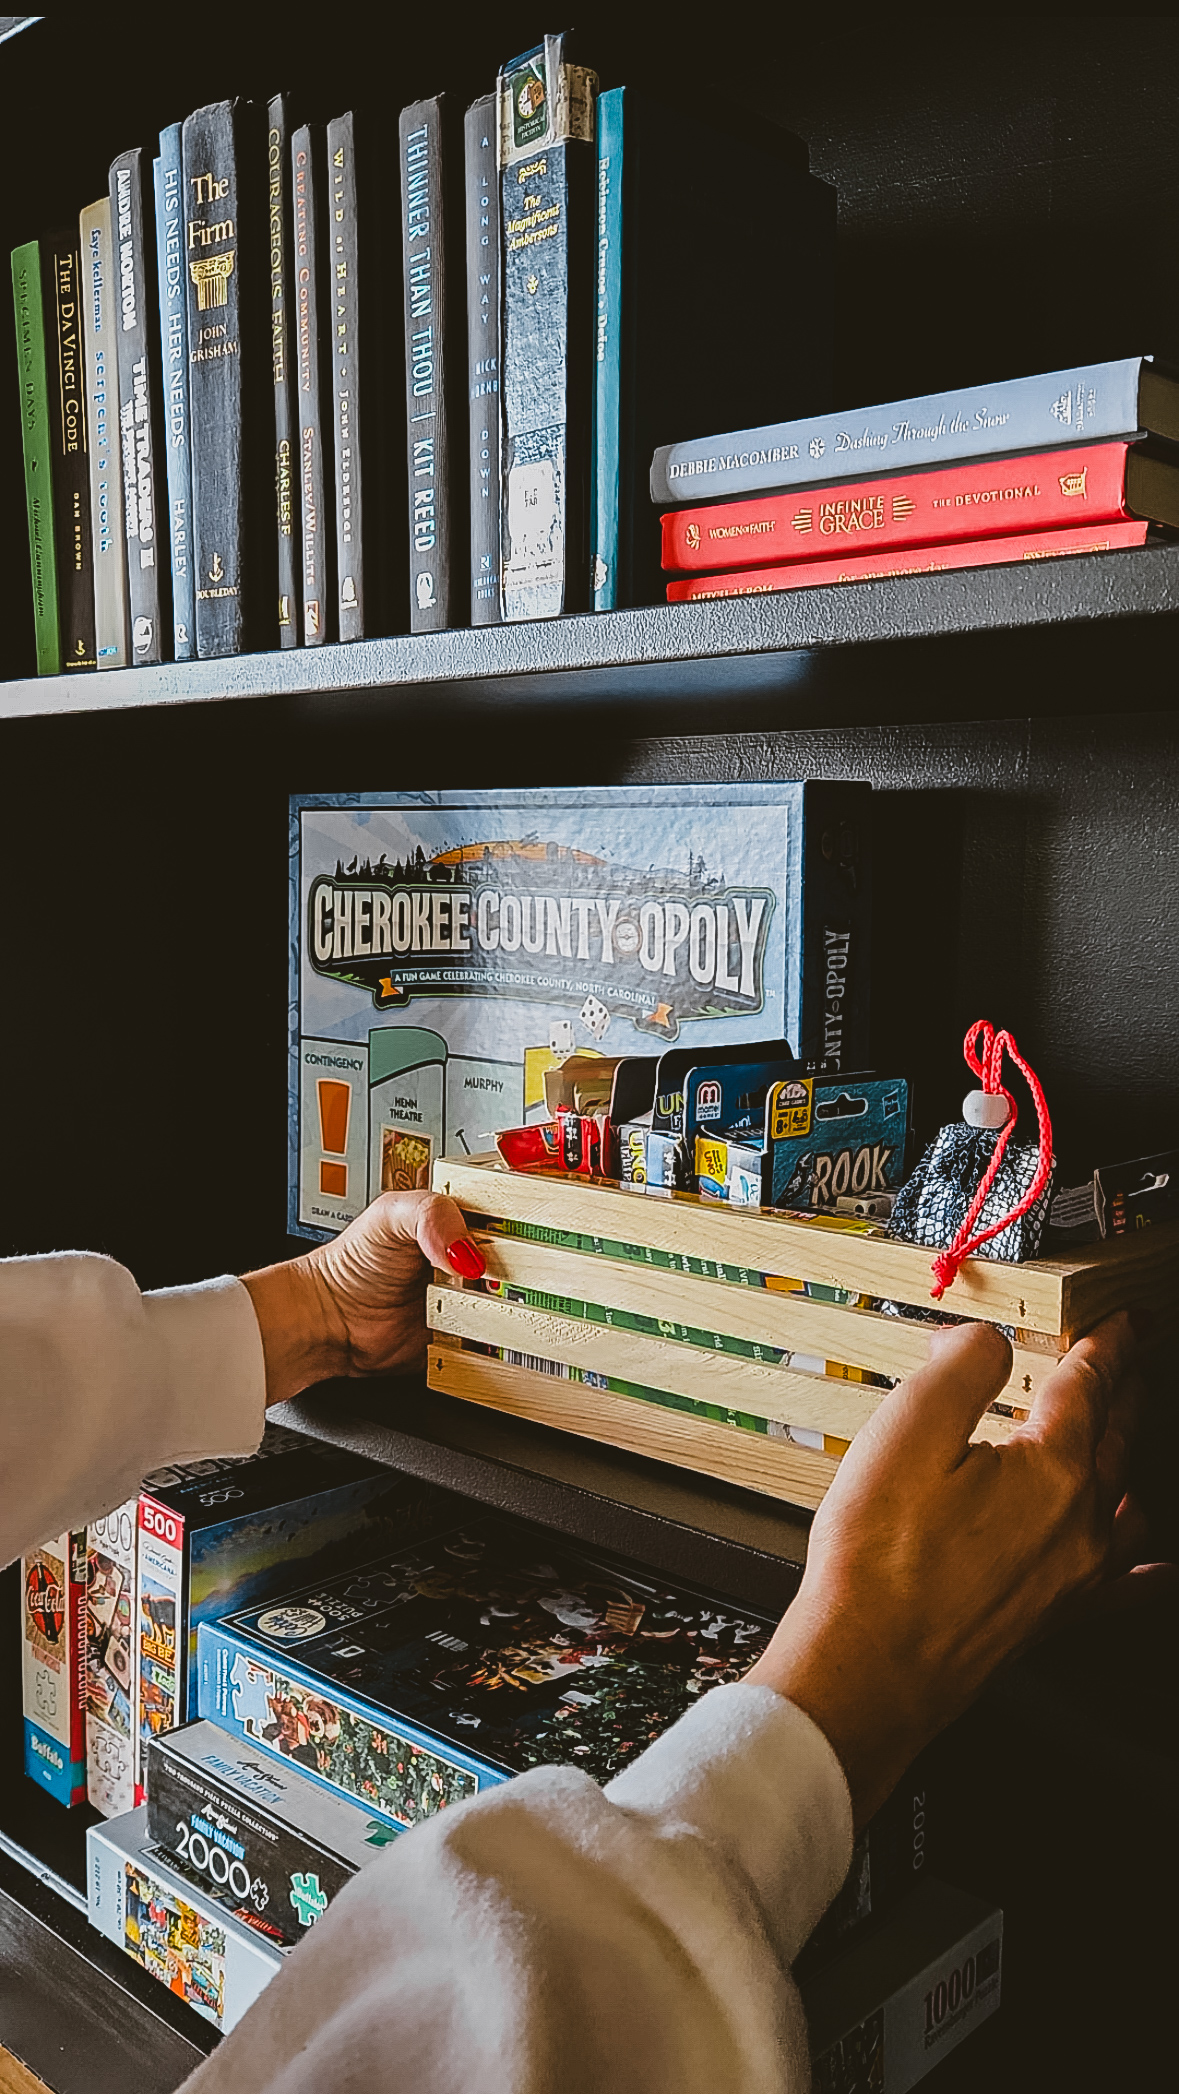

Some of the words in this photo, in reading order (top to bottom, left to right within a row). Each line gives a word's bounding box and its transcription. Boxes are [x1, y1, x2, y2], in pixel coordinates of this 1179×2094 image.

[117, 169, 132, 241] ANDRE
[164, 169, 179, 212] HIS
[190, 173, 229, 205] The
[296, 152, 308, 257] CREATING
[333, 146, 345, 223] WILD
[406, 123, 431, 243] THINNER
[522, 194, 542, 212] The
[597, 156, 610, 236] Robinson
[188, 219, 235, 250] Firm
[268, 128, 284, 299] COURAGEOUS
[480, 176, 490, 246] LONG
[506, 203, 561, 236] Magnificent
[508, 223, 559, 251] Ambersons
[59, 254, 73, 294] THE
[120, 241, 138, 332] NORTON
[408, 248, 433, 319] THAN
[597, 238, 609, 296] Crusoe
[19, 269, 33, 373] SPECIMEN
[61, 301, 75, 332] DA
[336, 262, 347, 355] HEART
[479, 273, 491, 325] WAY
[168, 312, 182, 361] HER
[189, 341, 238, 363] GRISHAM
[198, 324, 228, 345] JOHN
[271, 309, 286, 386] FAITH
[299, 268, 311, 393] COMMUNITY
[596, 314, 608, 362] Defoe
[62, 334, 77, 391] VINCI
[410, 327, 434, 398] THOU
[475, 357, 497, 377] NICK
[25, 381, 35, 431] DAYS
[92, 260, 103, 334] kellerman
[99, 481, 114, 553] tooth
[132, 356, 150, 424] TIME
[169, 371, 185, 448] NEEDS
[65, 400, 79, 453] CODE
[669, 456, 716, 480] DEBBIE
[718, 443, 800, 473] MACOMBER
[834, 429, 889, 454] Dashing
[891, 414, 946, 444] Through
[949, 412, 970, 435] the
[972, 408, 1010, 431] Snow
[135, 422, 154, 543] TRADERS
[278, 440, 291, 522] CHARLES
[412, 437, 435, 477] KIT
[479, 429, 491, 499] DOWN
[413, 488, 437, 552] REED
[819, 496, 885, 516] INFINITE
[819, 510, 885, 535] GRACE
[933, 498, 951, 508] THE
[955, 485, 1041, 507] DEVOTIONAL
[173, 499, 187, 578] HARLEY
[708, 525, 743, 540] WOMEN
[749, 521, 776, 535] FAITH
[196, 586, 239, 600] DOUBLEDAY
[314, 884, 470, 961] CHEROKEE
[477, 889, 621, 964] COUNTY
[639, 897, 767, 997] OPOLY
[395, 973, 401, 982] A
[402, 972, 418, 982] FUN
[419, 971, 441, 981] GAME
[443, 971, 493, 983] CELEBRATING
[495, 973, 536, 985] CHEROKEE
[575, 981, 605, 996] NORTH
[607, 986, 656, 1005] CAROLINA!
[304, 1053, 364, 1071] CONTINGENCY
[464, 1077, 504, 1092] MURPHY
[389, 1108, 423, 1123] THEATRE
[394, 1097, 418, 1109] HENN
[657, 1092, 685, 1119] UN
[811, 1145, 893, 1206] ROOK
[200, 1488, 244, 1506] 500
[142, 1507, 177, 1541] 500
[201, 1755, 236, 1777] FAMILY
[913, 1791, 926, 1870] 2000
[175, 1821, 251, 1899] 2000
[924, 1957, 975, 2035] 1000
